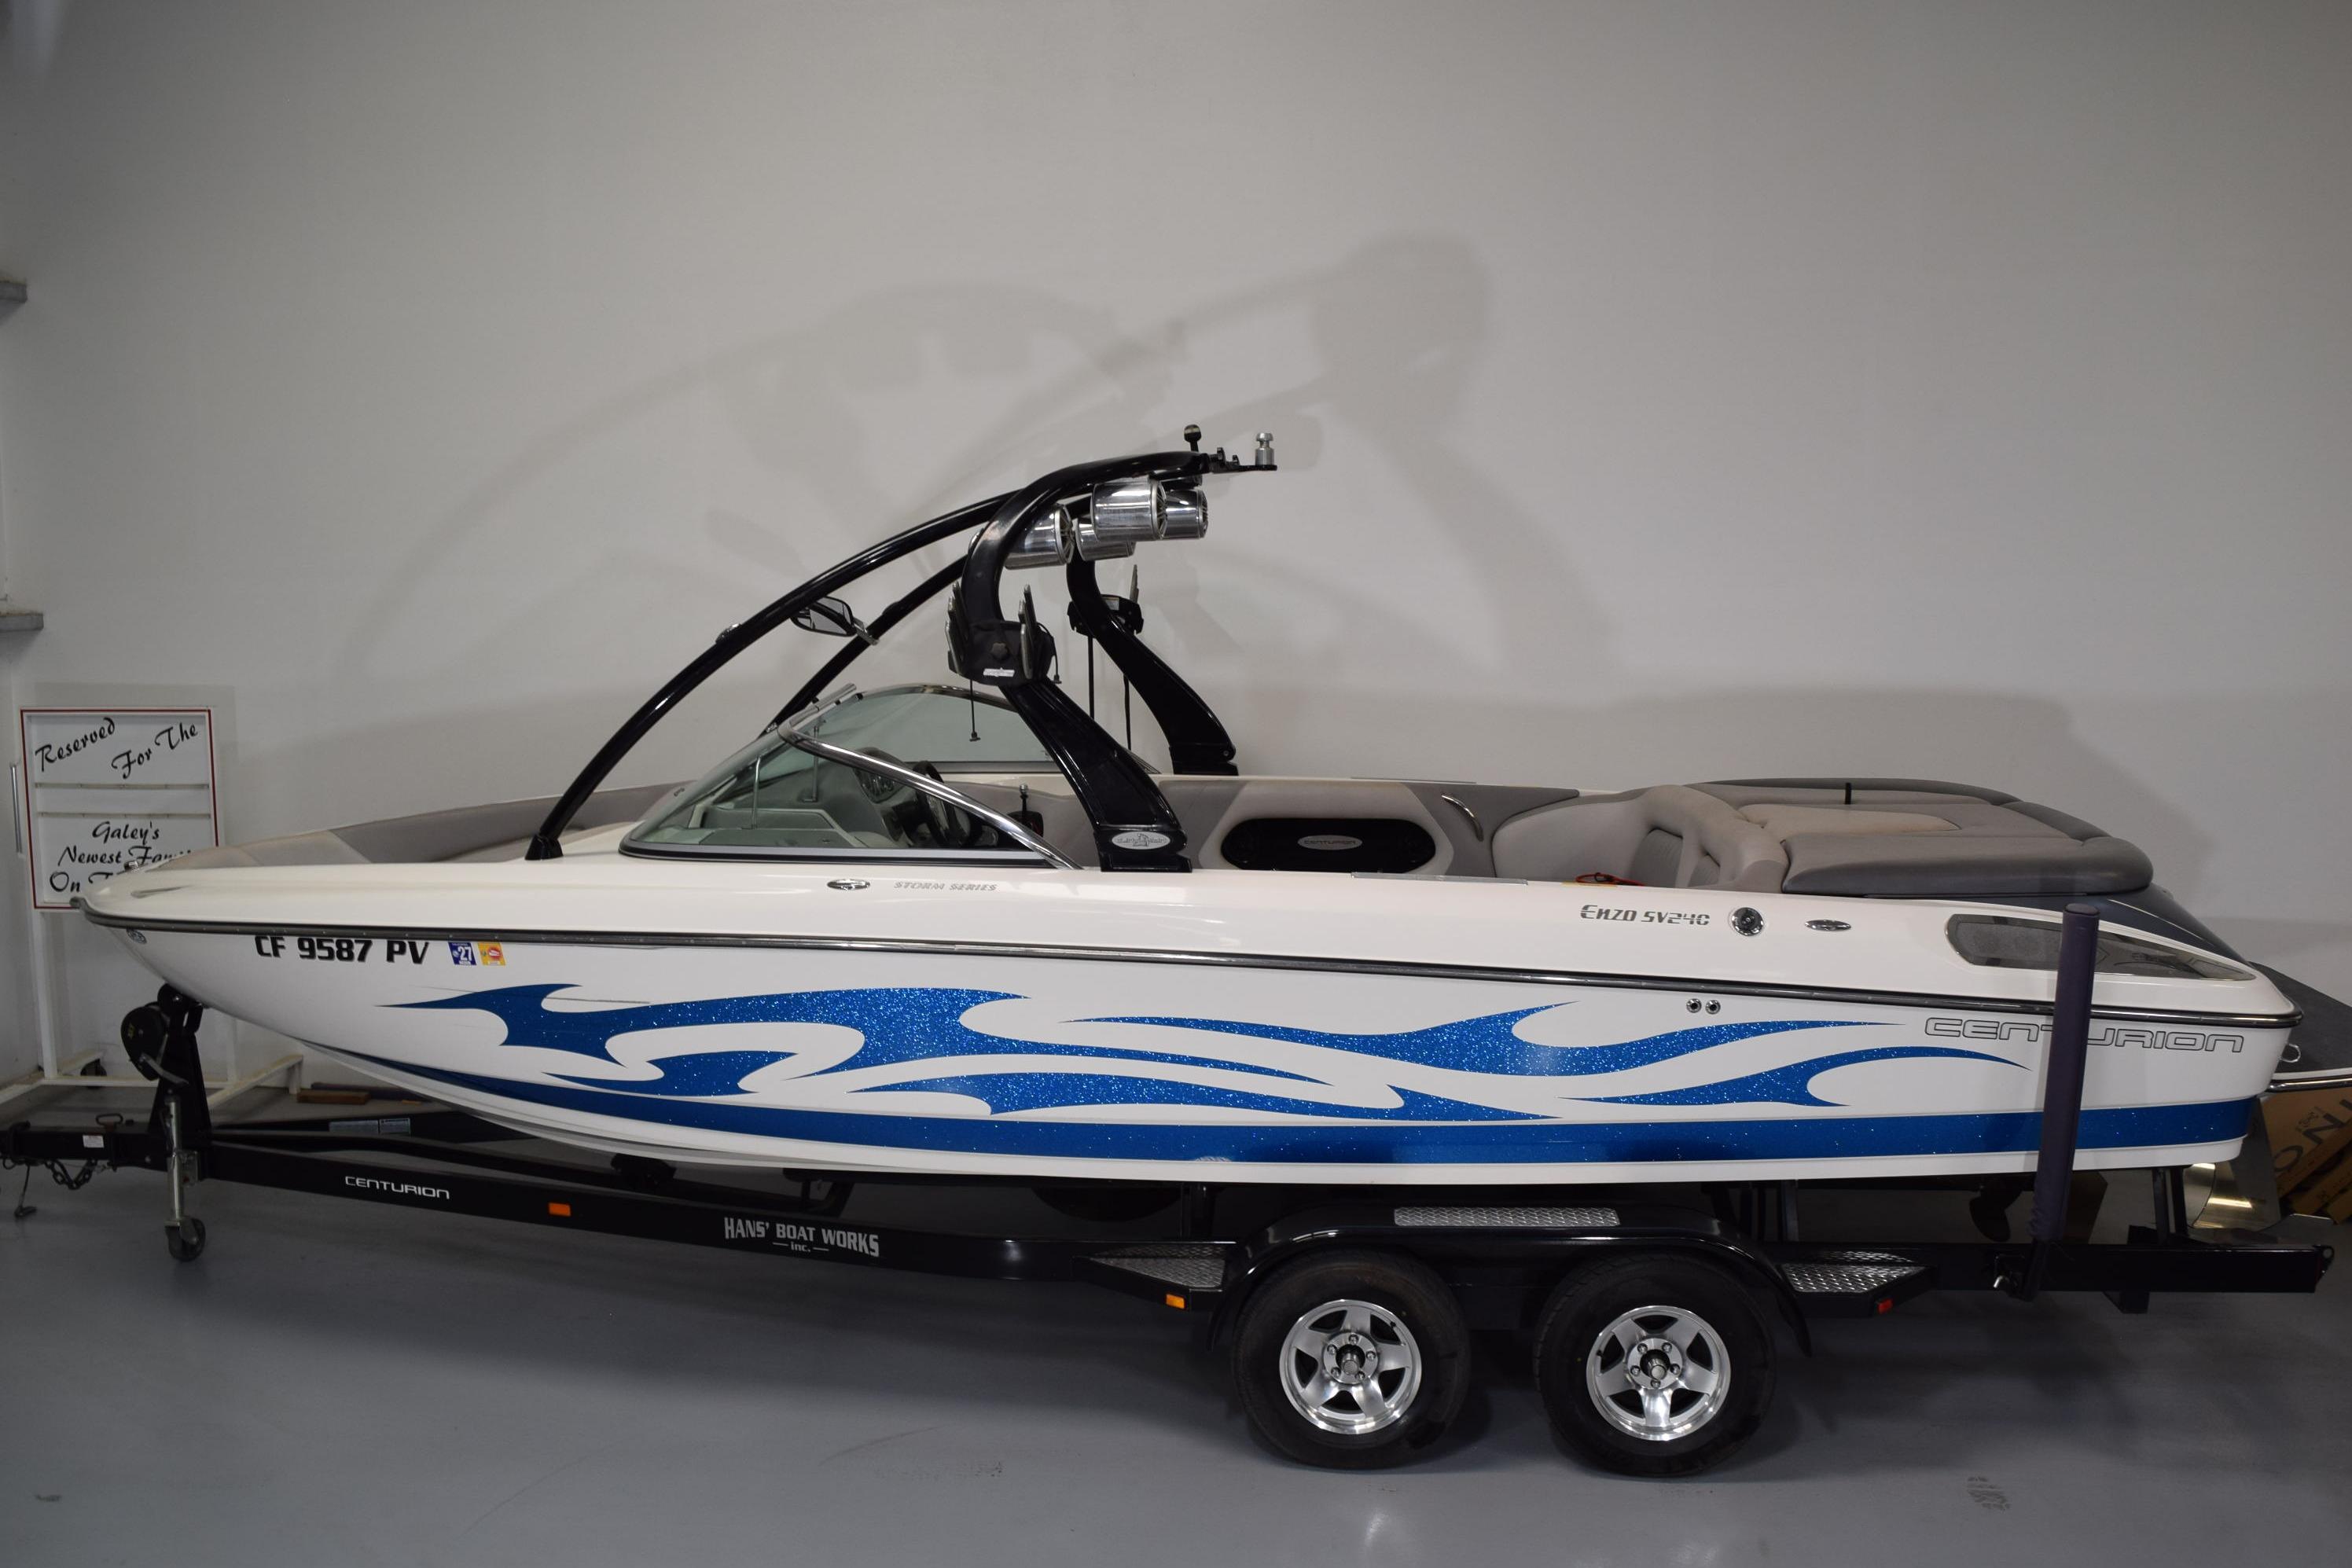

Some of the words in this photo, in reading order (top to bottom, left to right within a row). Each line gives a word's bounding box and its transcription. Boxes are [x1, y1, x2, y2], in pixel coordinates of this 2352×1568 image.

[35, 717, 116, 772] Reserved
[111, 747, 153, 779] For
[155, 723, 198, 751] The
[92, 821, 160, 845] Galey's
[57, 846, 122, 866] Newest
[50, 871, 81, 893] On
[893, 881, 945, 890] STORM
[949, 883, 998, 891] SERIES
[255, 935, 286, 957] CF
[296, 938, 373, 963] 9587
[386, 940, 429, 964] PV
[458, 946, 472, 961] 27
[1924, 1017, 2244, 1053] CENURION
[344, 1175, 450, 1200] CENTURION
[723, 1217, 770, 1239] HANS'
[775, 1223, 816, 1242] BOAT
[821, 1228, 880, 1258] WORKS
[790, 1242, 811, 1253] inc.
